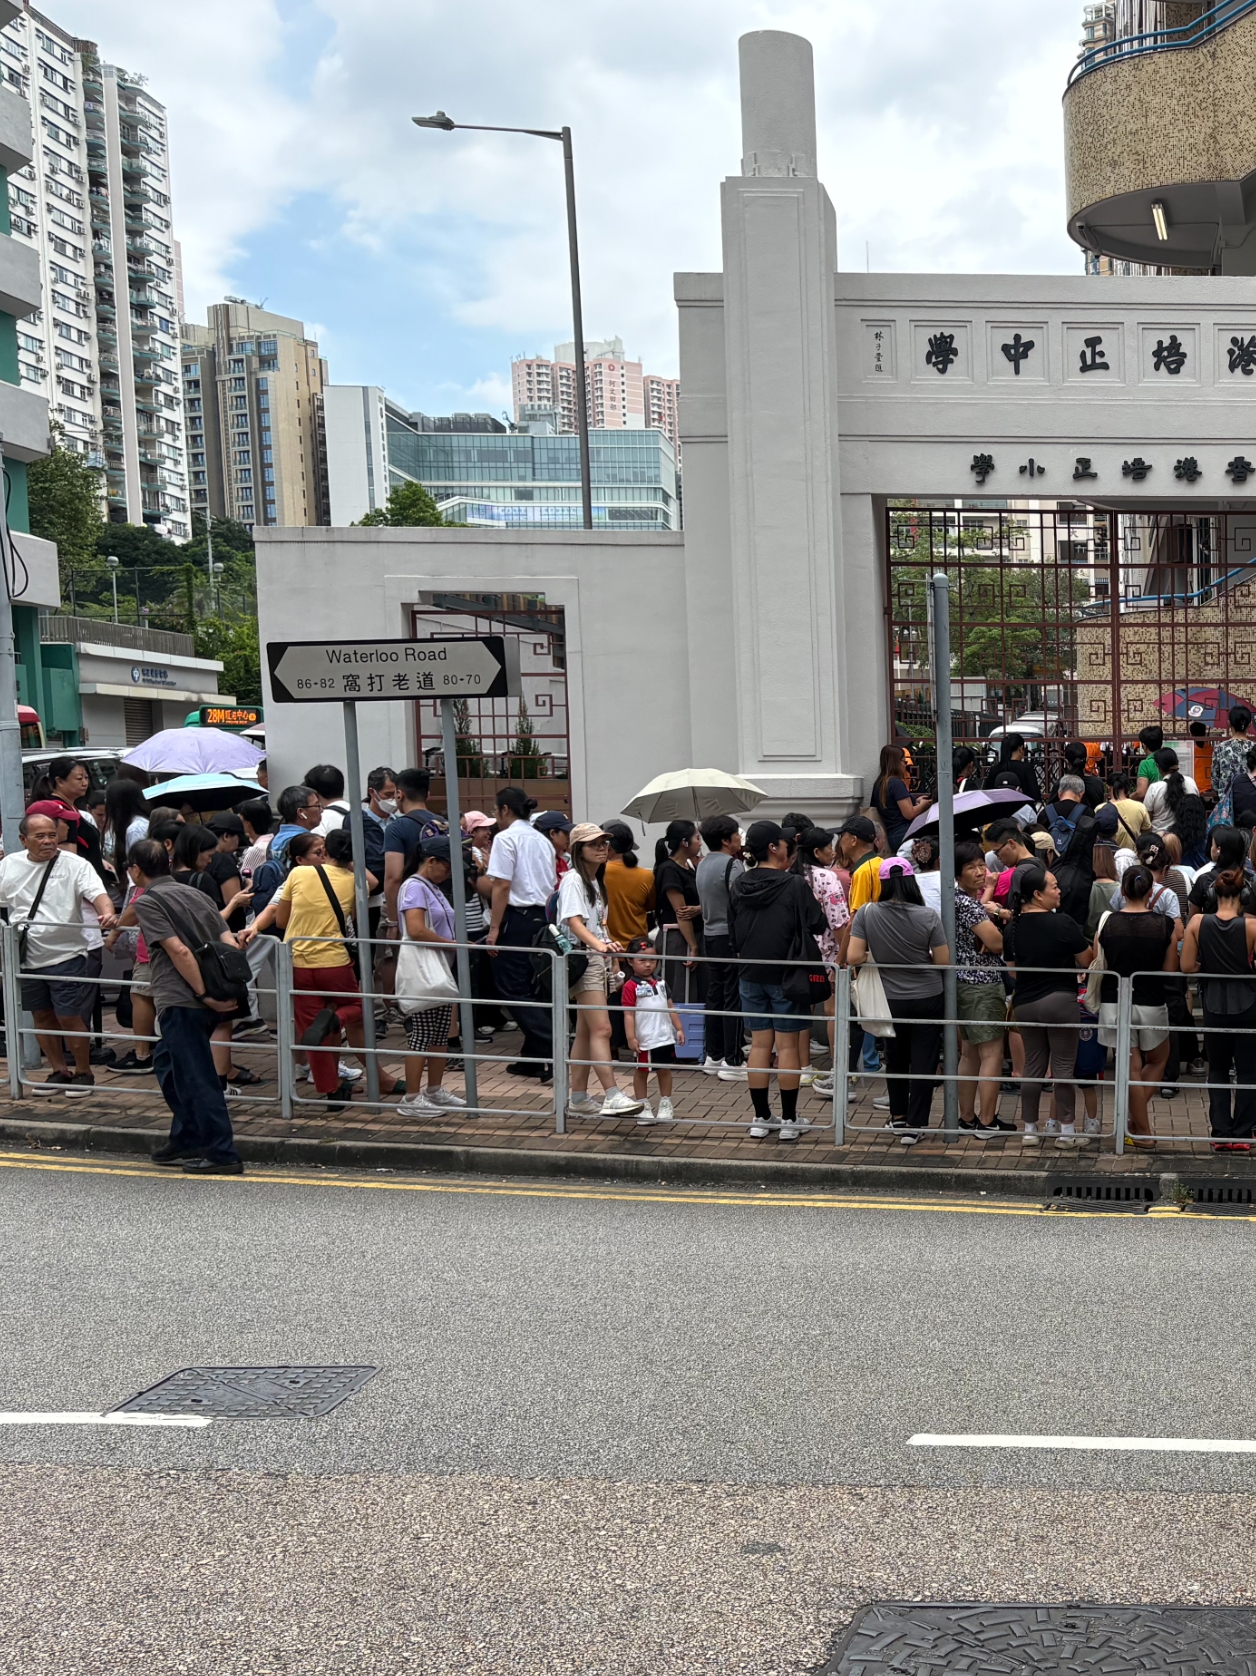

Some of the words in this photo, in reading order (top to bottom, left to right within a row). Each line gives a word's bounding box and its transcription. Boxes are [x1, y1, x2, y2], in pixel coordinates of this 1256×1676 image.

[970, 453, 1256, 484] 香港培正小學
[325, 648, 399, 664] Waterloo
[404, 647, 447, 662] Road
[342, 671, 436, 693] 窩打老道
[207, 708, 225, 723] 28M
